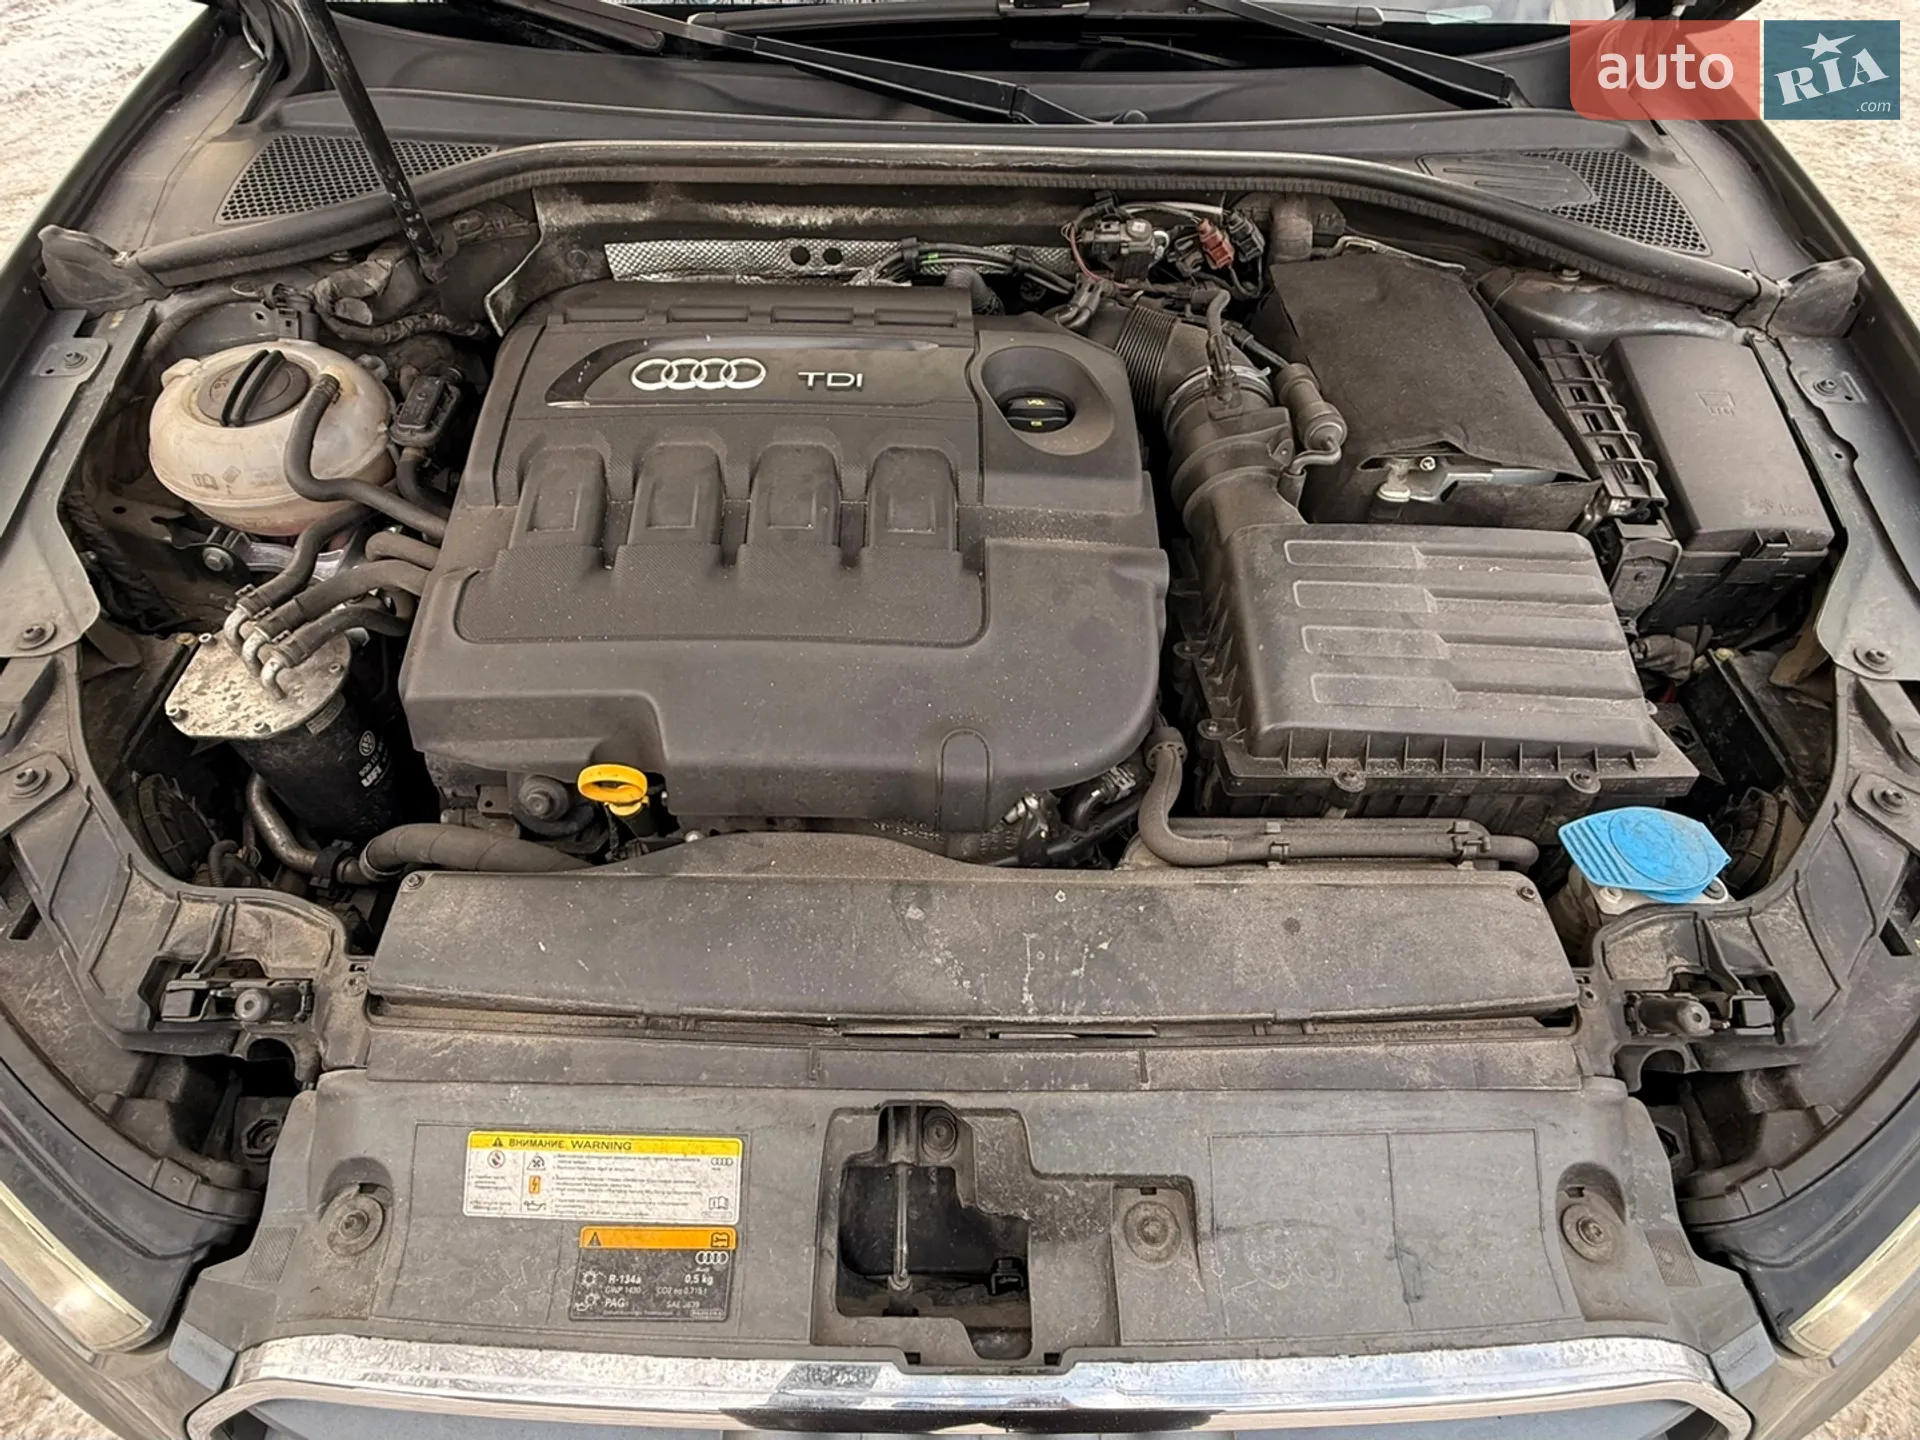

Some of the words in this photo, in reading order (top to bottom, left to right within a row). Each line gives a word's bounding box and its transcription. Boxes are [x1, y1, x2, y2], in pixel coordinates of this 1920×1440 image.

[797, 372, 863, 388] TDI
[508, 1138, 564, 1149] ВНИМАНИЕ
[570, 1140, 632, 1151] WARNING
[701, 1274, 714, 1286] kg
[604, 1297, 625, 1308] PAG
